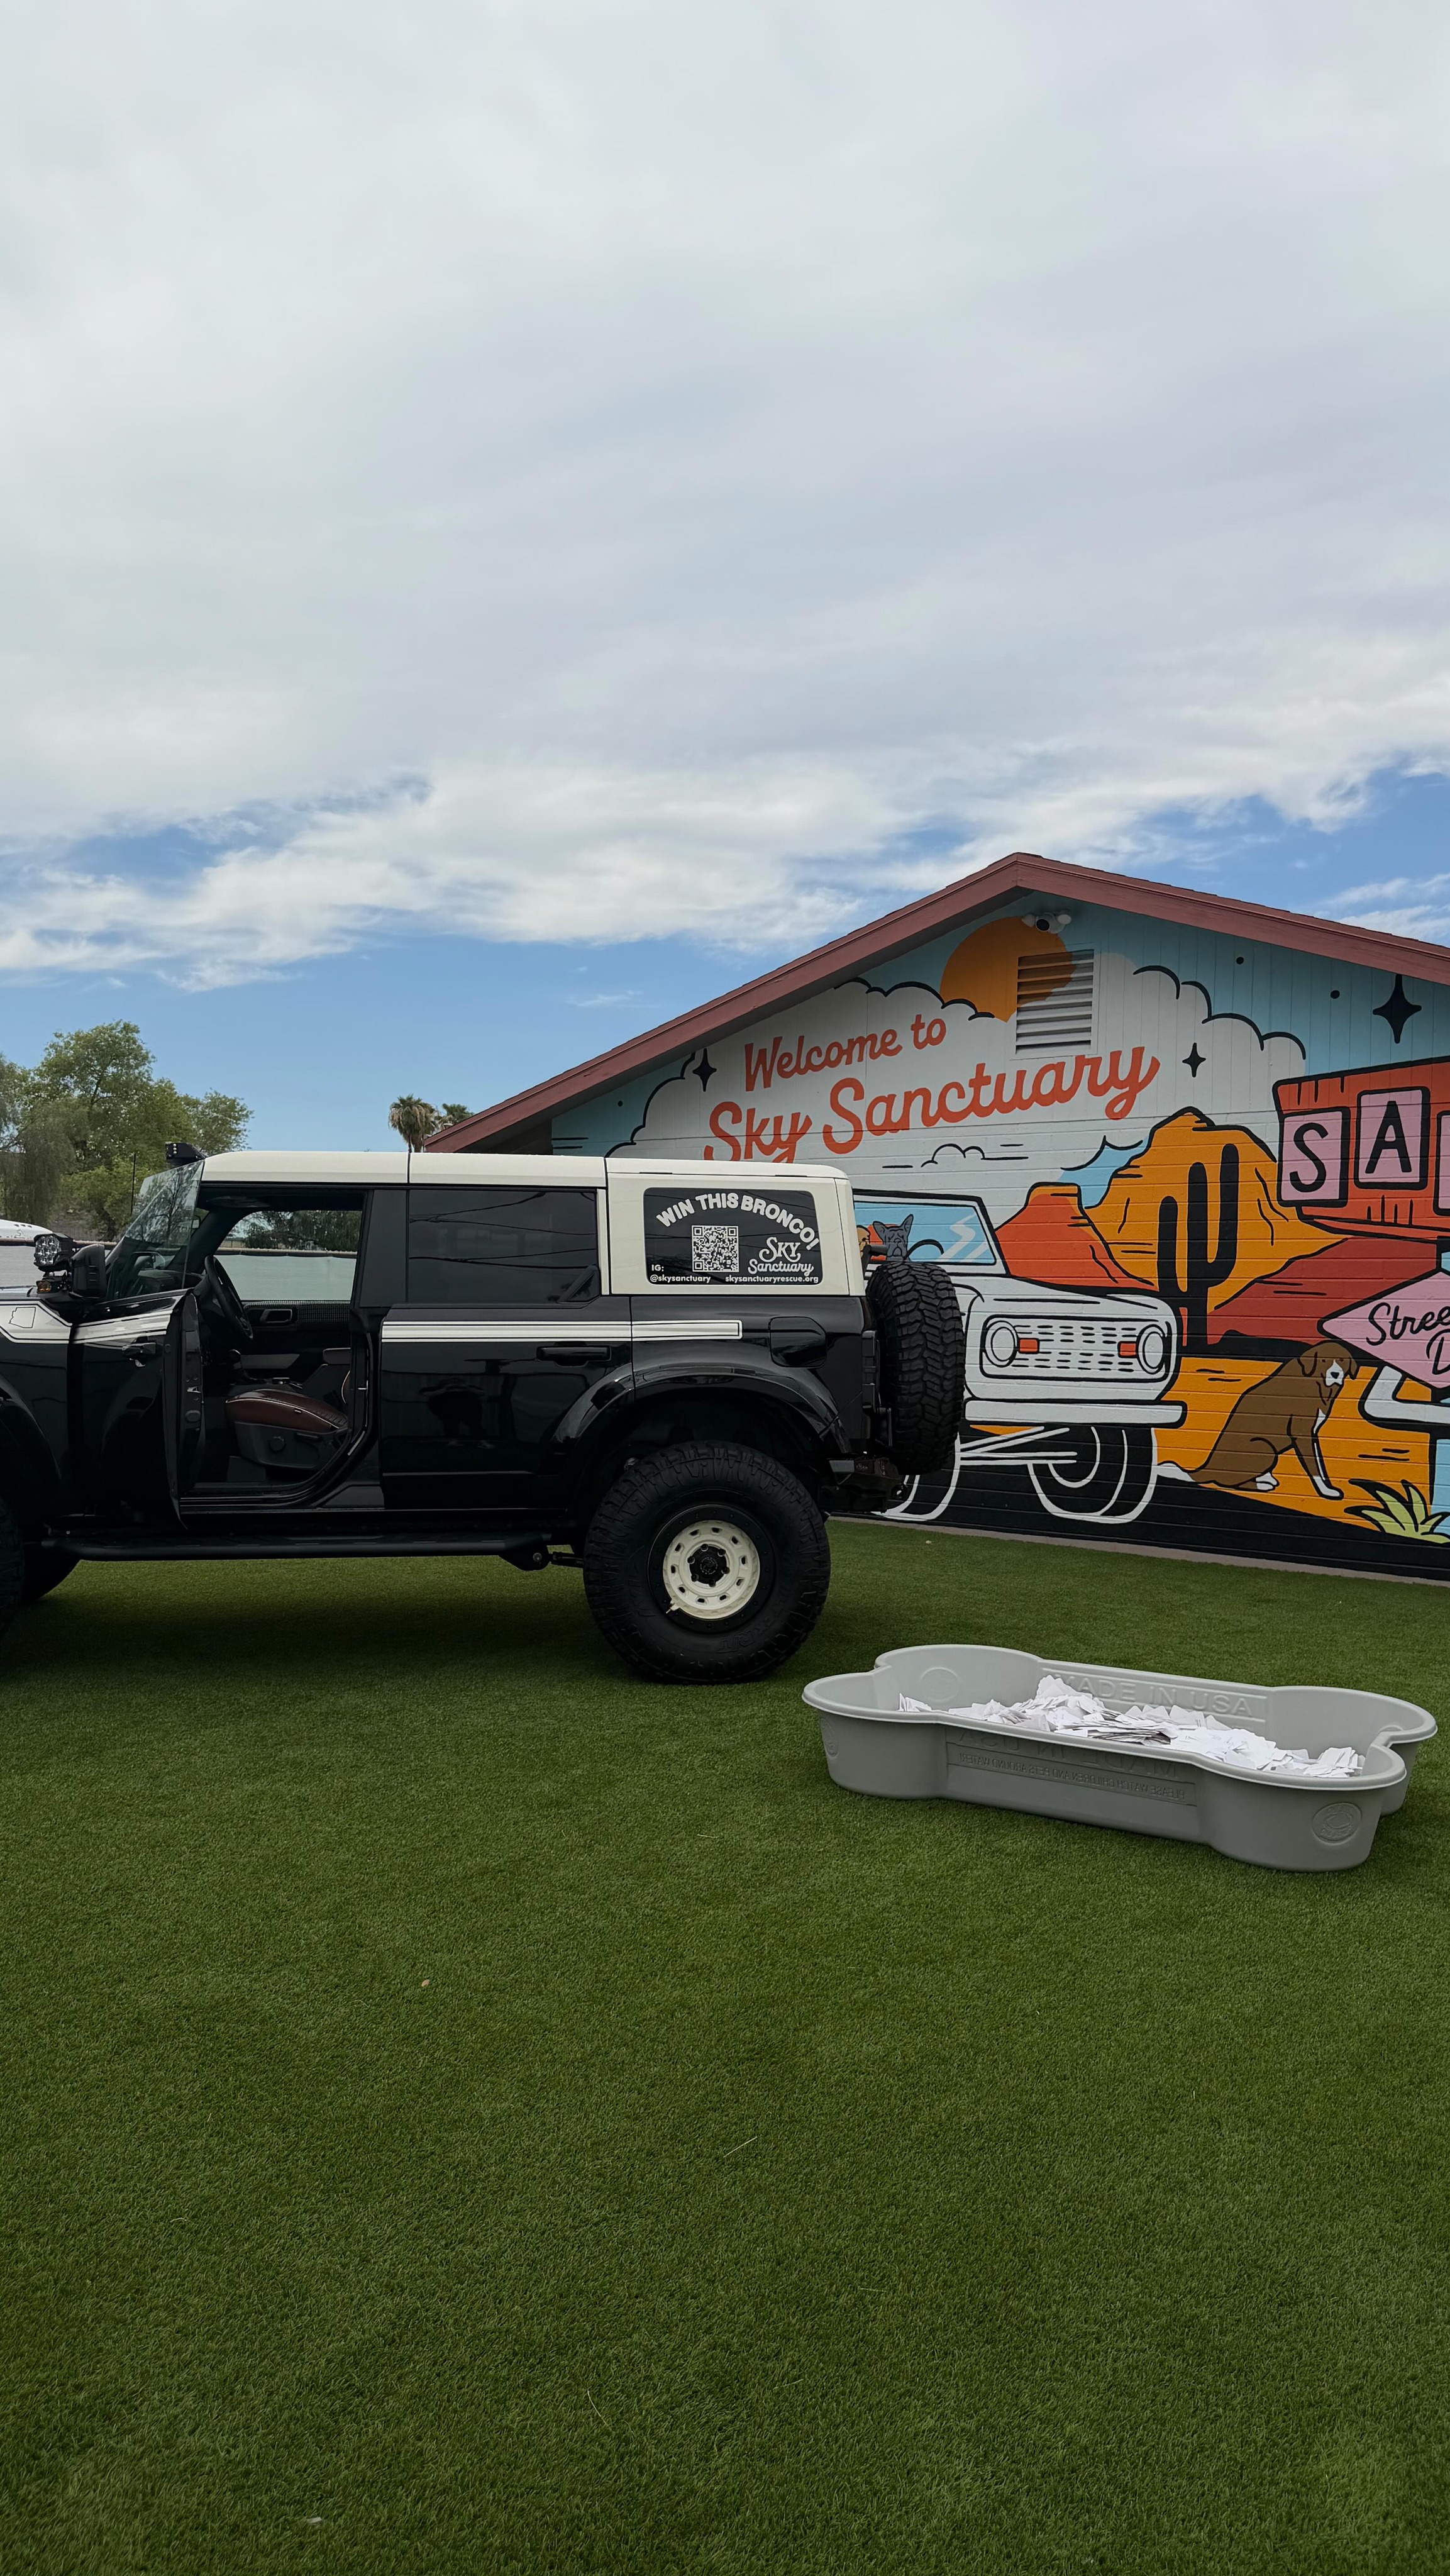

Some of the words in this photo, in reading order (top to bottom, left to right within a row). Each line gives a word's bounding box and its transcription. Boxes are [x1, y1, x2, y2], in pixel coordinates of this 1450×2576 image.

[744, 1027, 902, 1092] Welcome
[911, 1014, 946, 1050] to
[704, 1101, 812, 1163] Sky
[823, 1046, 1160, 1154] Sanctuary
[656, 1199, 695, 1227] WIN
[695, 1192, 739, 1211] THIS
[741, 1195, 819, 1251] BRONCO!
[650, 1274, 711, 1284] @skysanctuary
[725, 1275, 819, 1284] skysanctuaryrescue.org
[748, 1258, 814, 1277] Sanctuary
[1149, 1685, 1178, 1706] IN
[1190, 1690, 1253, 1716] USA
